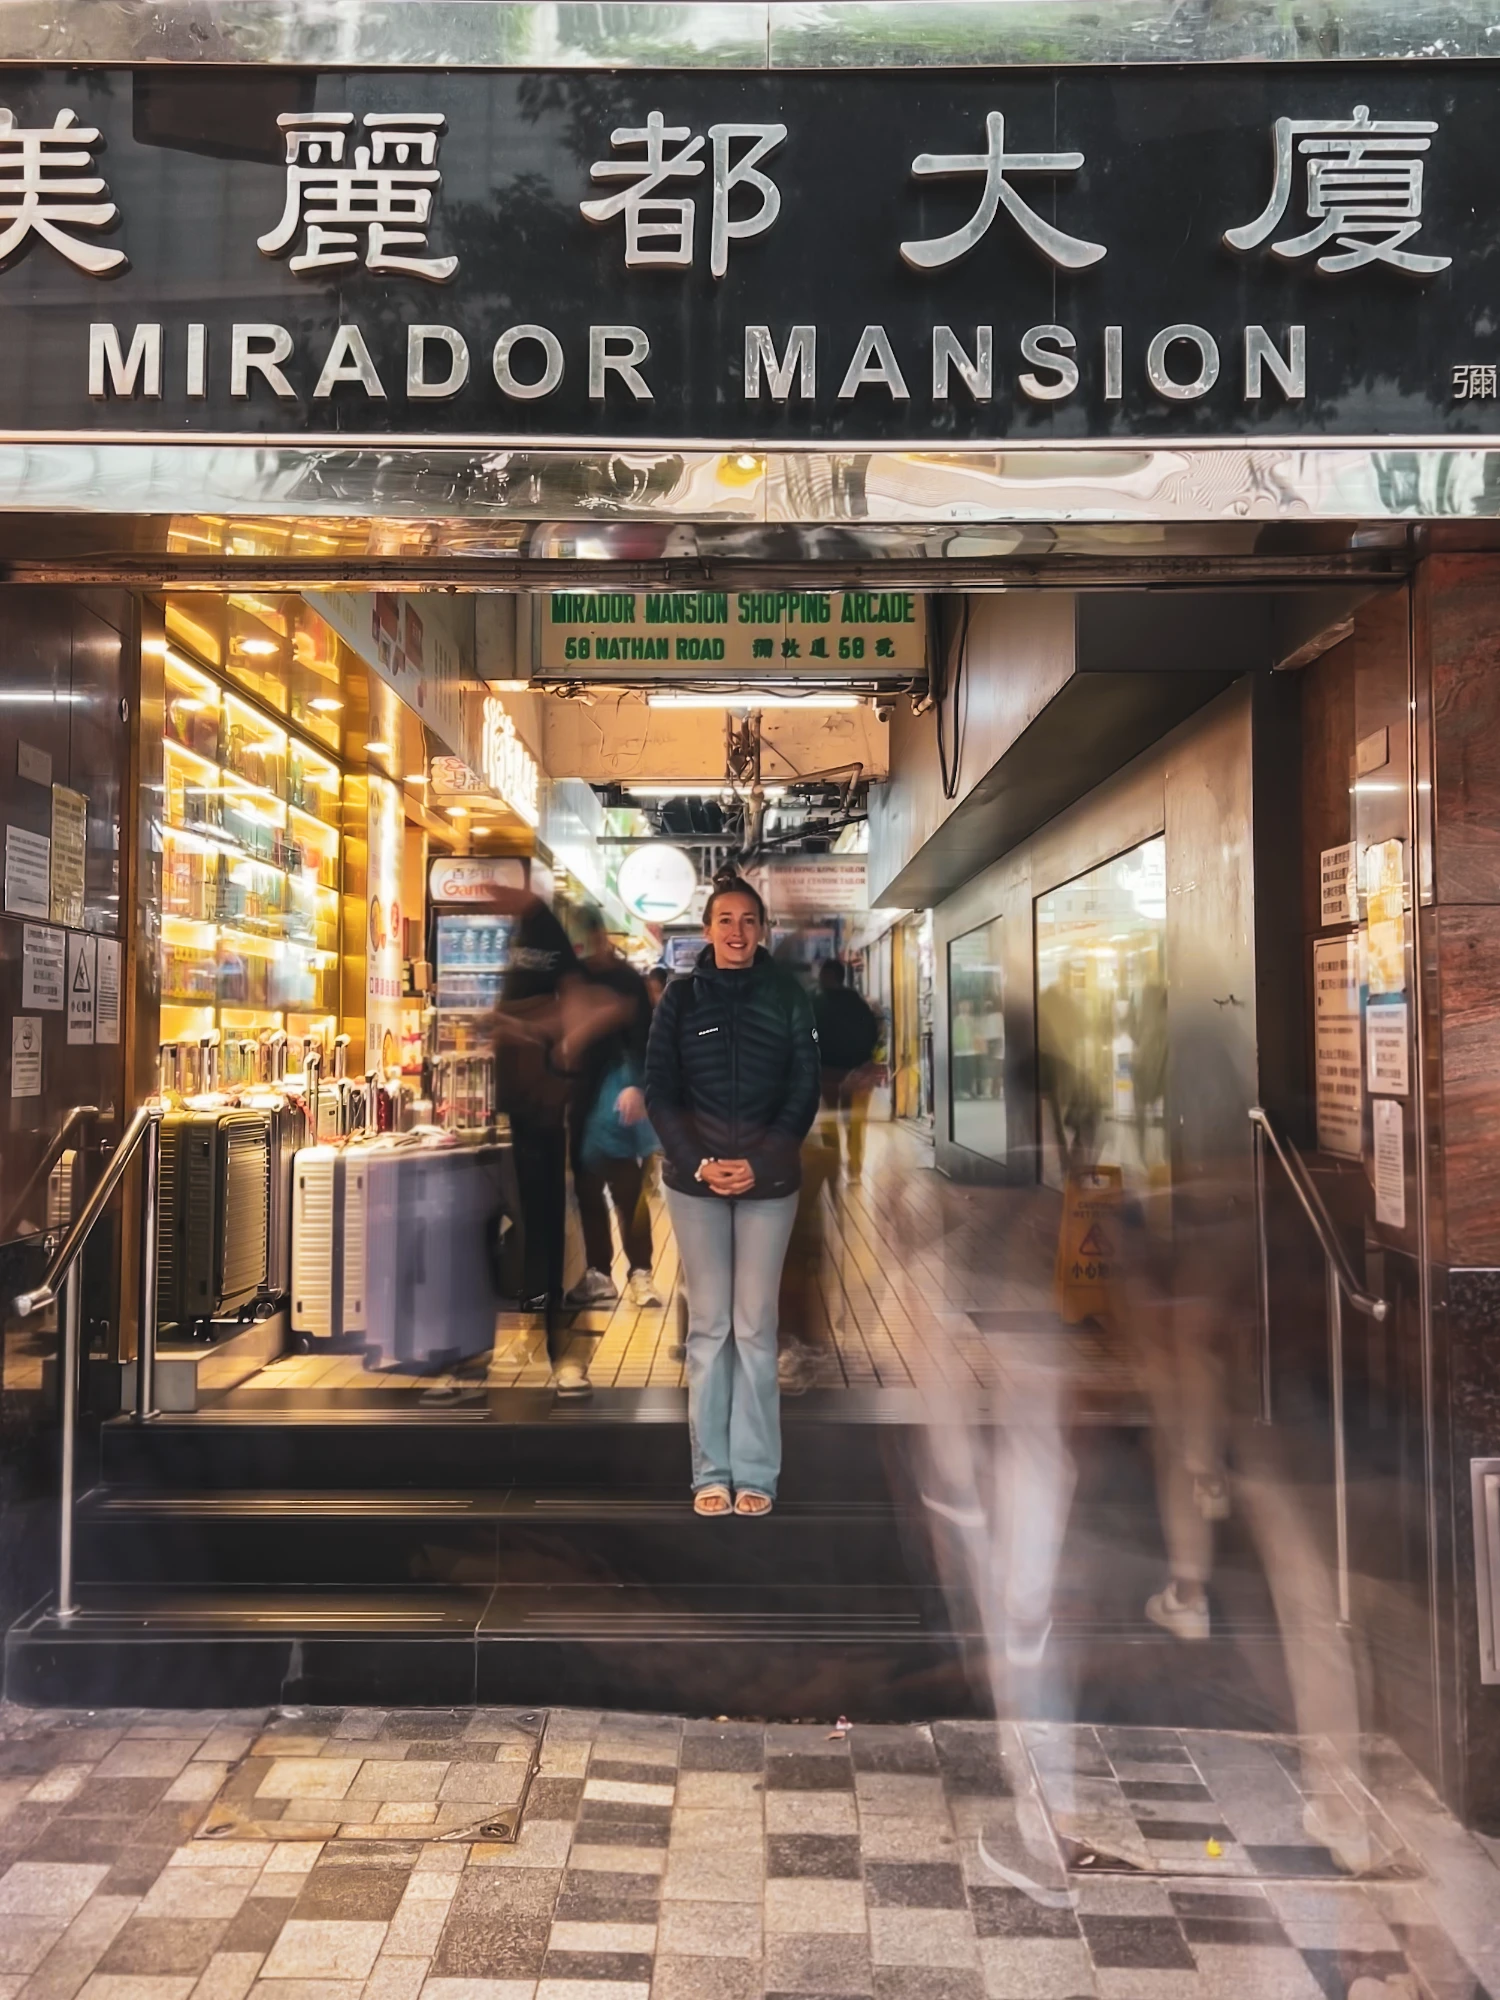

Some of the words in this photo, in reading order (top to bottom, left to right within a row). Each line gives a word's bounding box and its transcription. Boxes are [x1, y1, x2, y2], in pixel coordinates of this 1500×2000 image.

[0, 105, 1453, 281] 美麗都大廈
[88, 322, 655, 400] MIRADOR
[744, 322, 1307, 400] MANSION
[551, 593, 636, 624] MIRADOR
[645, 592, 728, 624] MANSION
[737, 592, 831, 624] SHOPPING
[840, 592, 916, 624] ARCADE
[564, 637, 591, 660] 58
[595, 637, 669, 661] NATHAN
[676, 637, 725, 661] ROAD
